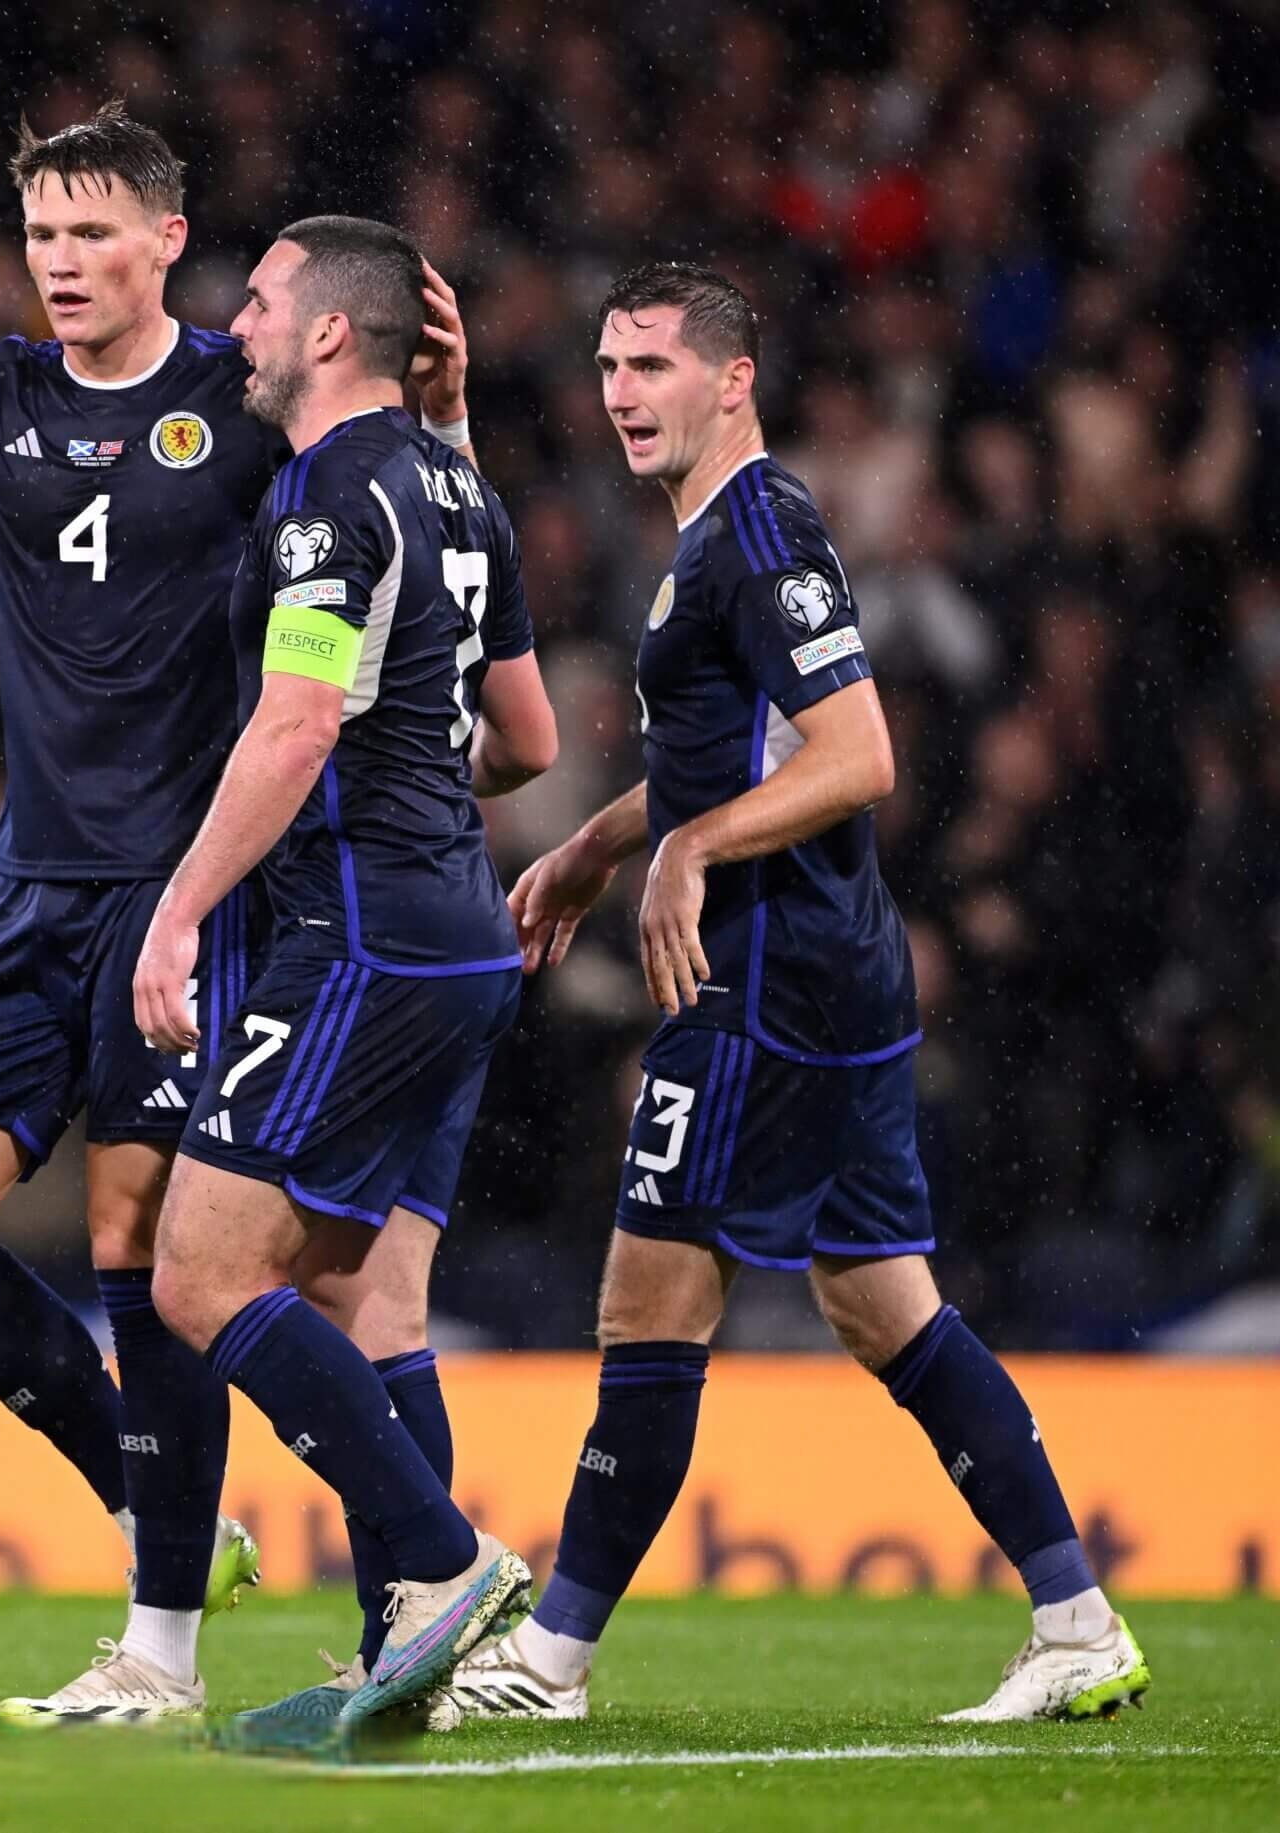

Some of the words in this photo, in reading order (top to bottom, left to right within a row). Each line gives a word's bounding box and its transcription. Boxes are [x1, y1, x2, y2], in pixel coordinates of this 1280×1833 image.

[58, 494, 111, 582] 4
[278, 632, 337, 656] RESPECT
[220, 1013, 292, 1098] 7
[6, 1387, 36, 1413] BA
[118, 1432, 160, 1455] LBA
[288, 1432, 318, 1458] BA
[950, 1451, 975, 1488] BA
